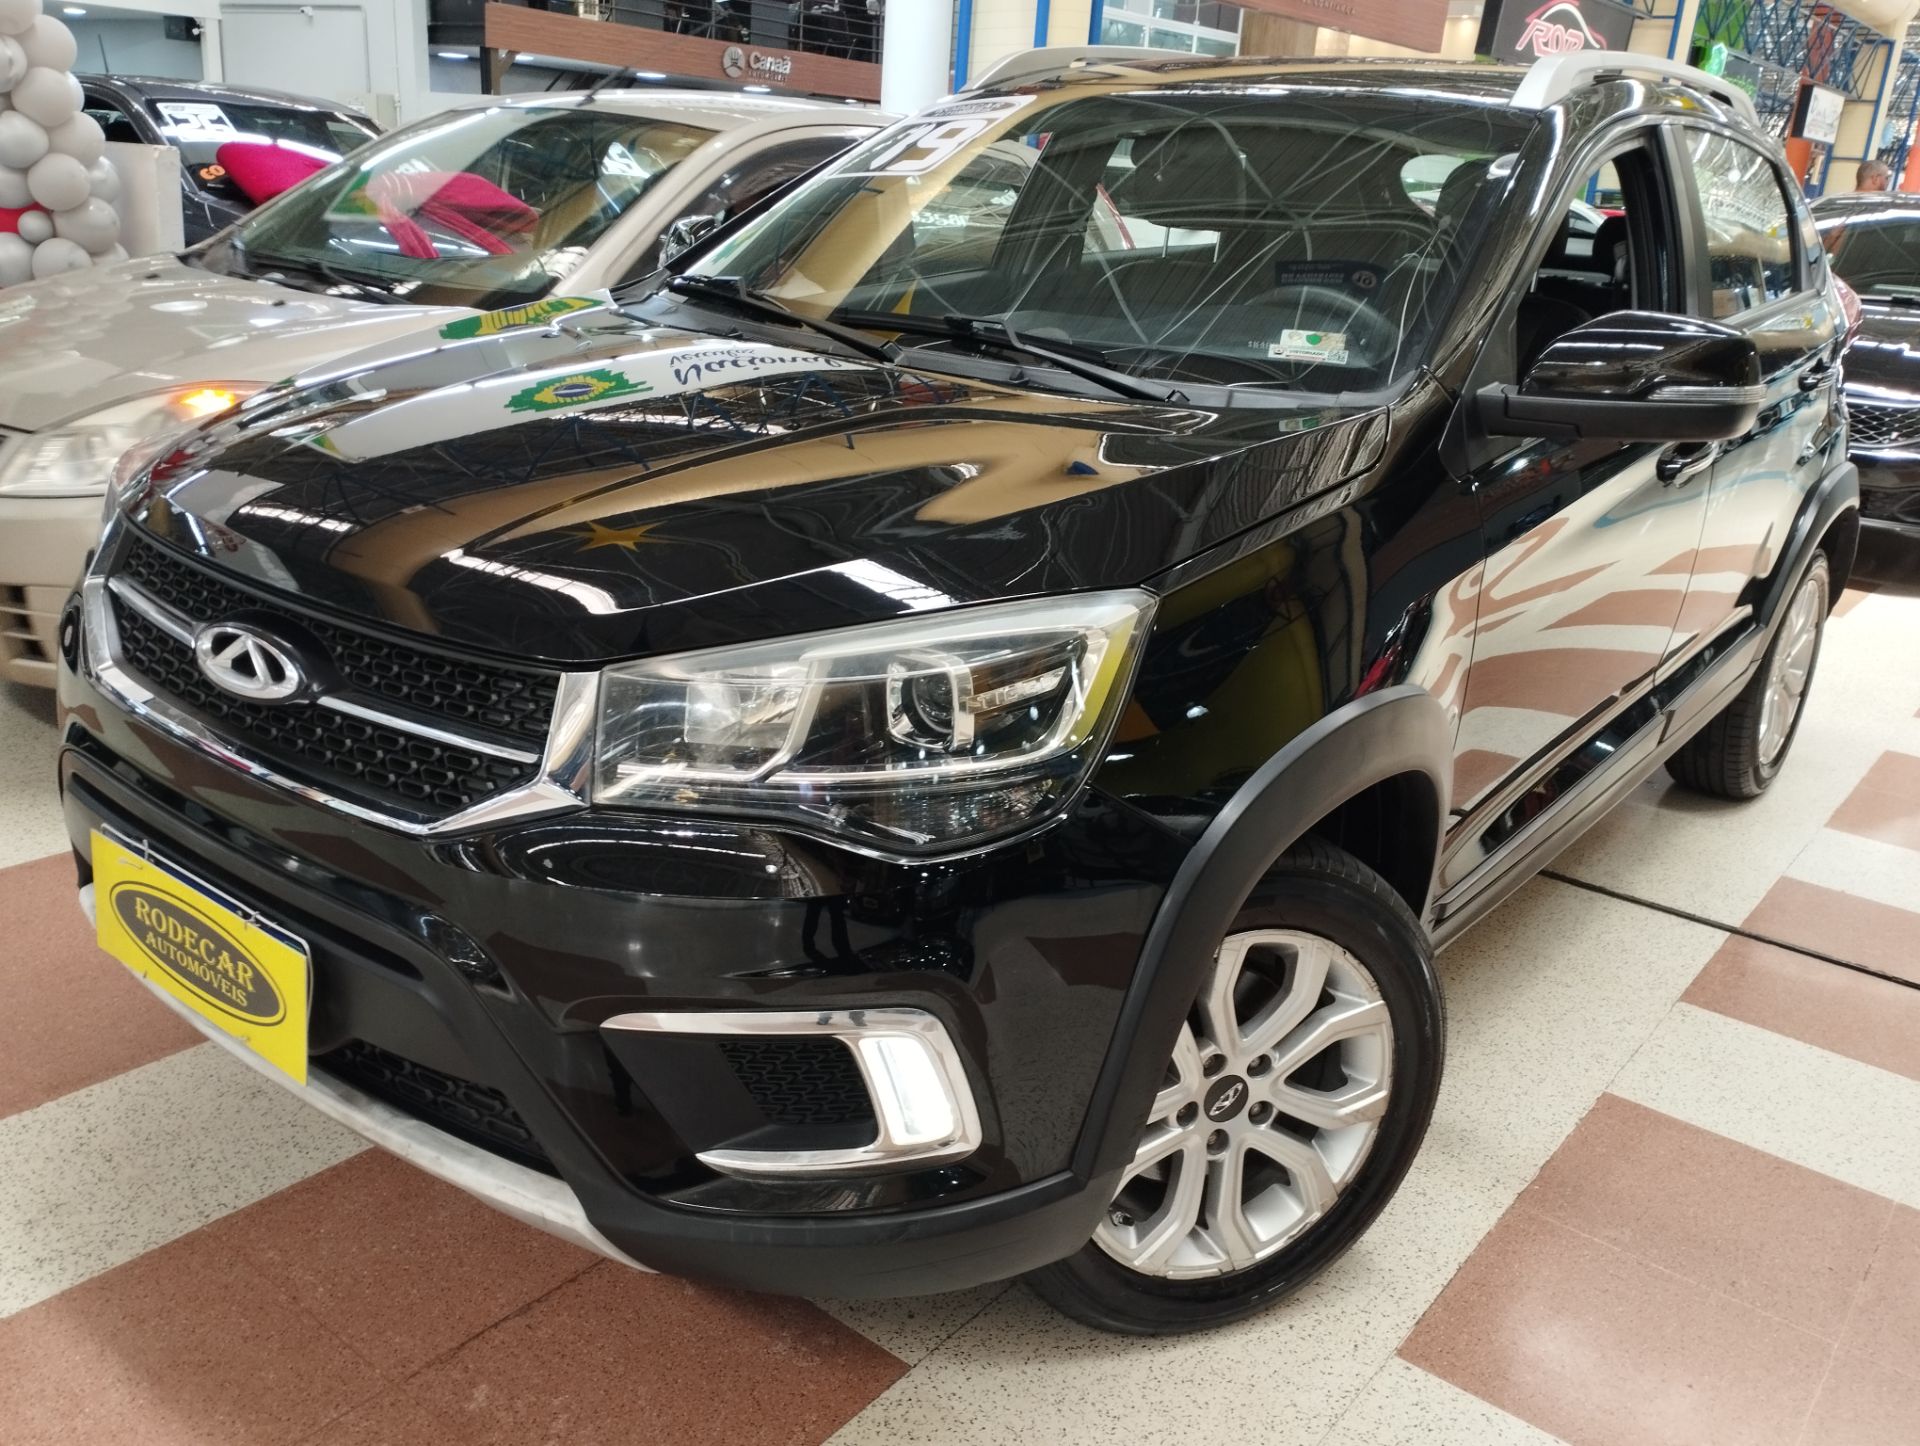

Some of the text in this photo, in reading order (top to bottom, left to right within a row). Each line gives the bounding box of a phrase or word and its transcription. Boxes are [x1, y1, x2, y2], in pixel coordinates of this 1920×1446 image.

[749, 51, 791, 74] Canaã
[134, 896, 257, 993] RODECAR
[145, 931, 248, 1008] AUTOMÓVEIS
